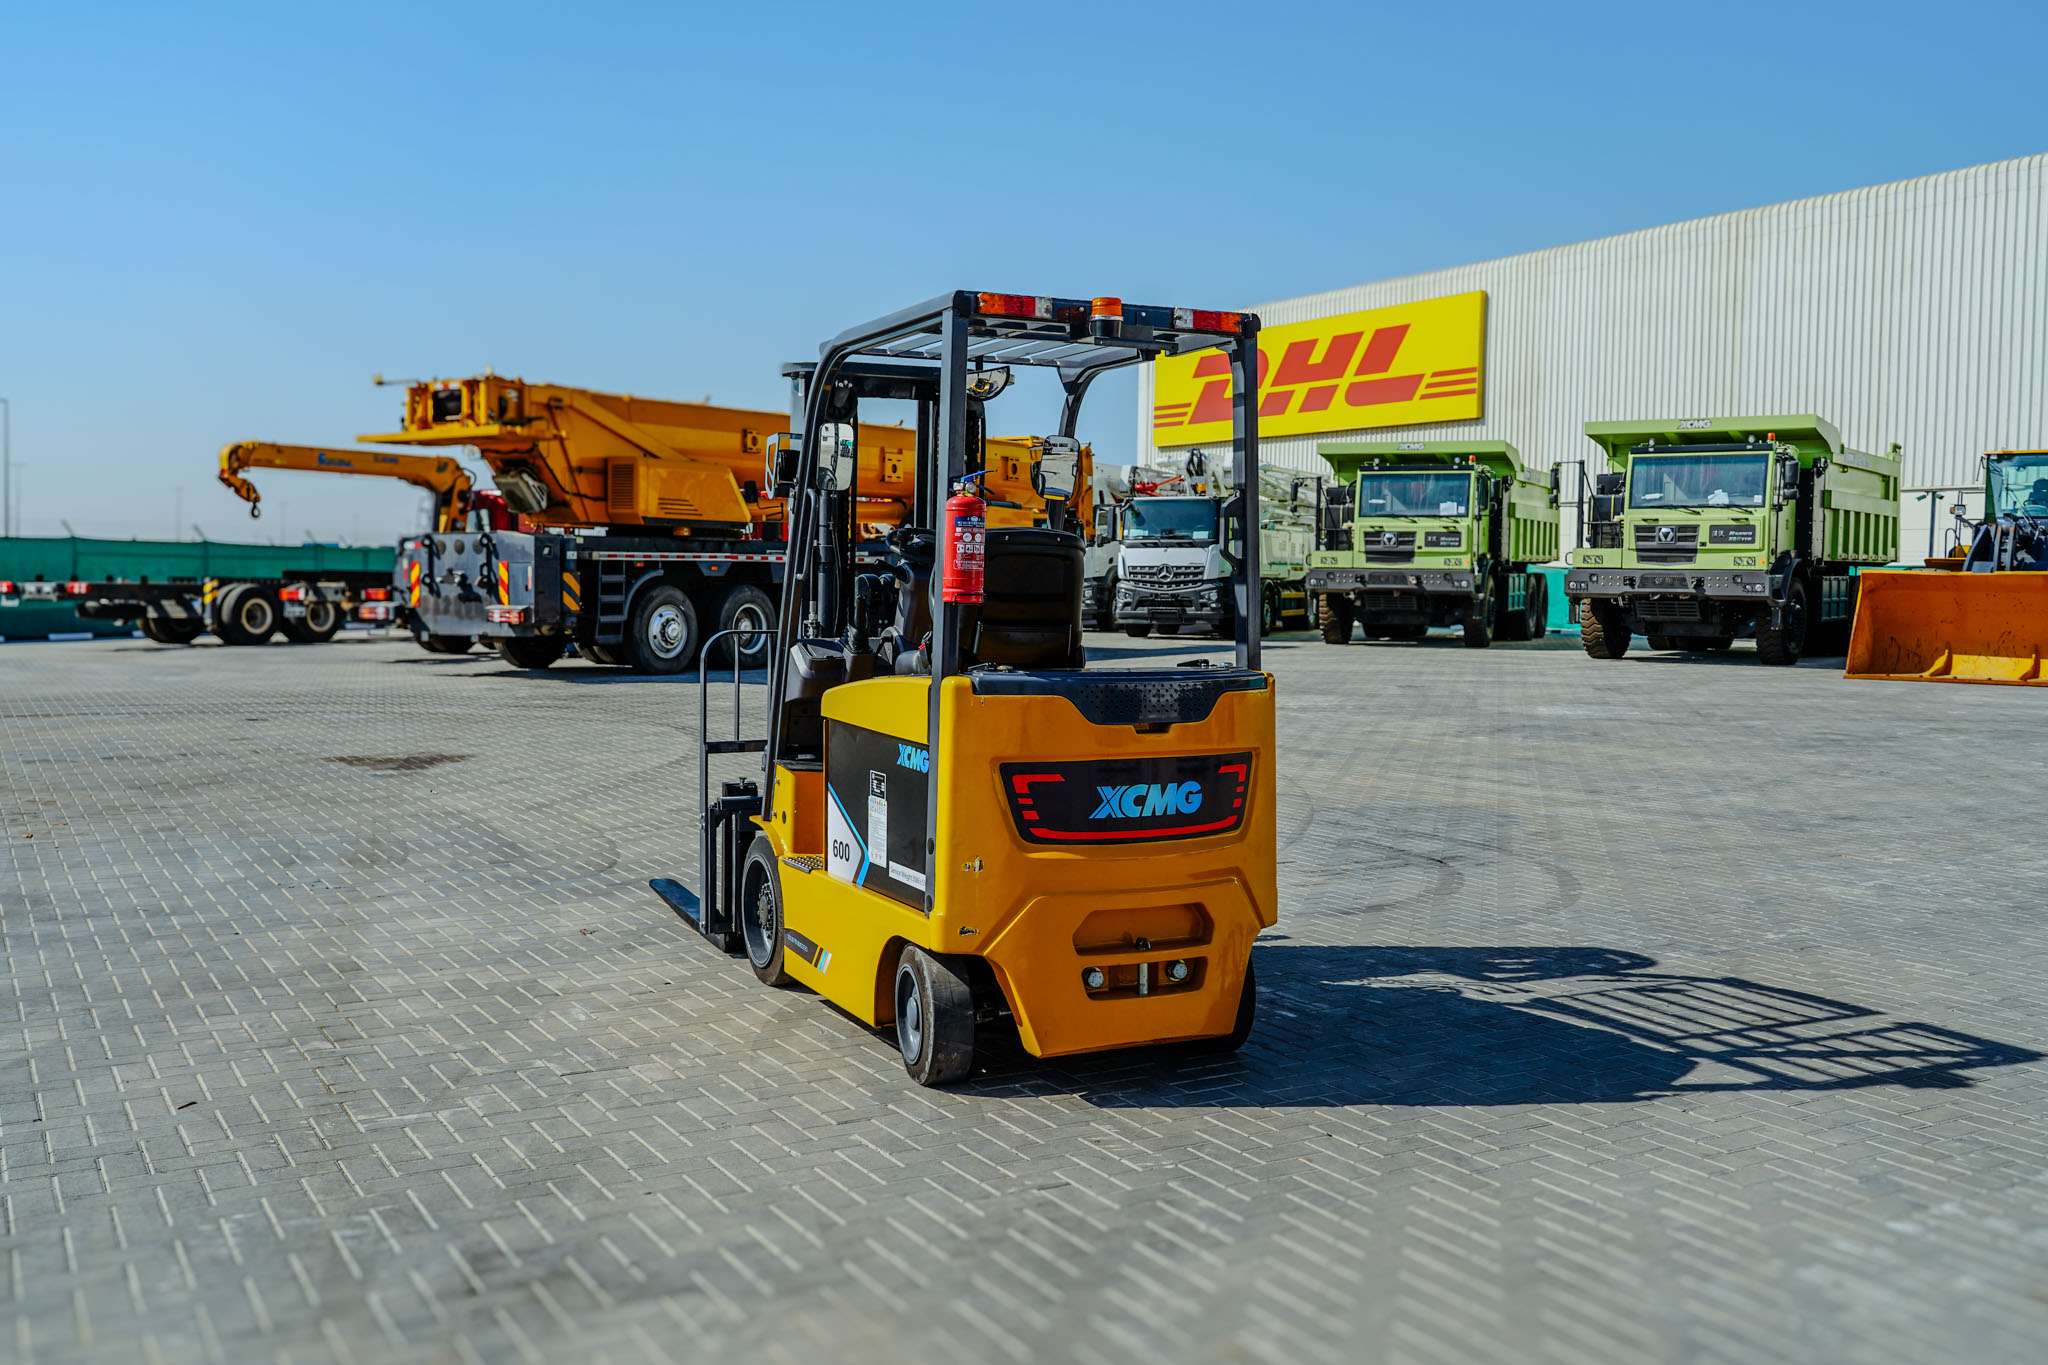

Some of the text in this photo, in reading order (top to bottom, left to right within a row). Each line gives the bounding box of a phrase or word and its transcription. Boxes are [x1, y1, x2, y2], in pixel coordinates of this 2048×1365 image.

[1188, 323, 1426, 425] DHL
[1678, 419, 1711, 429] XCMG
[1397, 442, 1424, 450] XCMG
[896, 743, 929, 773] XCMG
[1089, 780, 1203, 819] XCMG
[832, 839, 850, 862] 600
